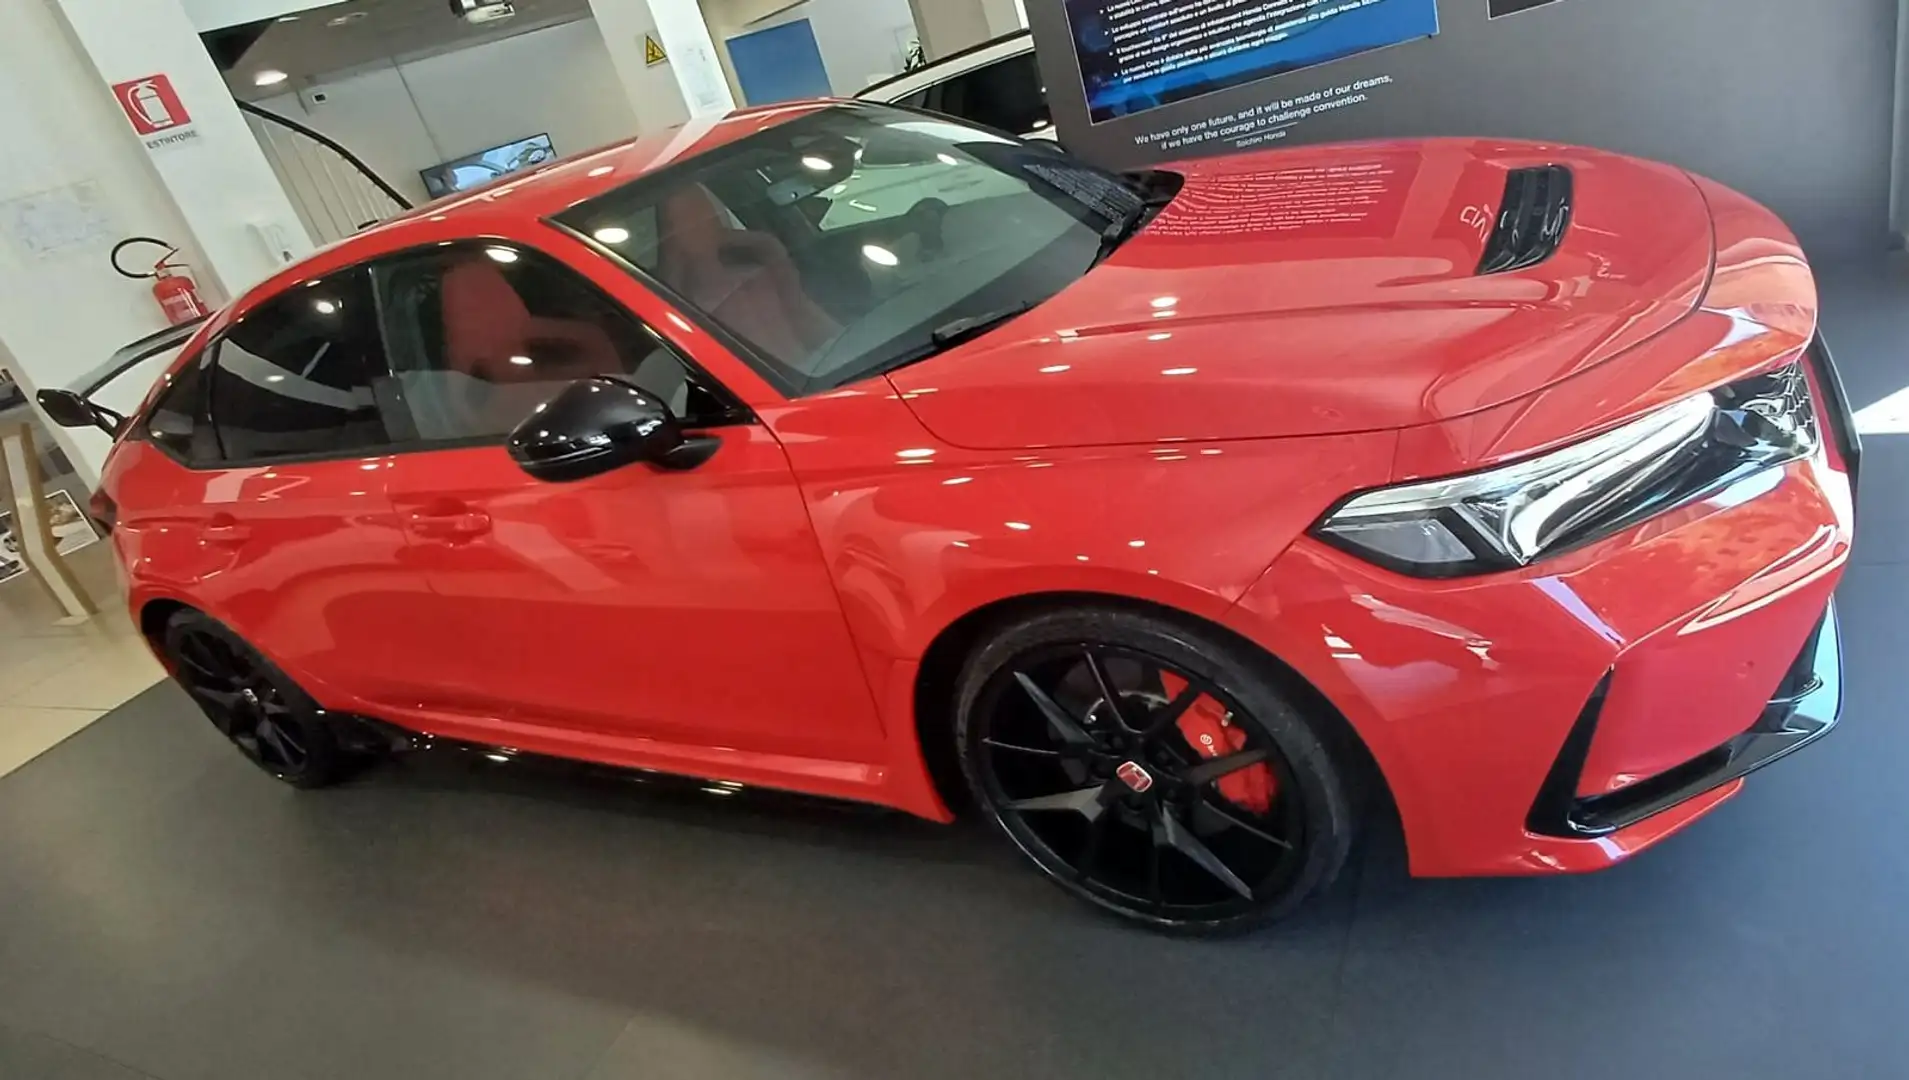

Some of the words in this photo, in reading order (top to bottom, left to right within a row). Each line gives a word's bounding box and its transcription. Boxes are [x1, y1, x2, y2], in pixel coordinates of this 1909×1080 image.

[1134, 136, 1149, 145] We
[1150, 130, 1170, 141] have
[1171, 125, 1189, 137] only
[1190, 121, 1207, 131] one
[1208, 114, 1236, 126] future,
[1238, 108, 1254, 120] and
[1256, 106, 1263, 115] it
[1264, 101, 1280, 113] will
[1280, 98, 1294, 108] be
[1295, 92, 1322, 105] made
[1323, 88, 1333, 98] of
[1335, 85, 1352, 95] our
[1353, 75, 1393, 91] dreams,
[1161, 142, 1168, 150] if
[1168, 140, 1181, 149] we
[1182, 134, 1202, 145] have
[1204, 130, 1218, 140] the
[1220, 122, 1255, 136] courage
[1257, 118, 1266, 127] to
[1268, 106, 1312, 124] challenge
[1313, 94, 1368, 113] convention.
[146, 130, 198, 149] ESTINTORE
[1264, 130, 1286, 141] Honda
